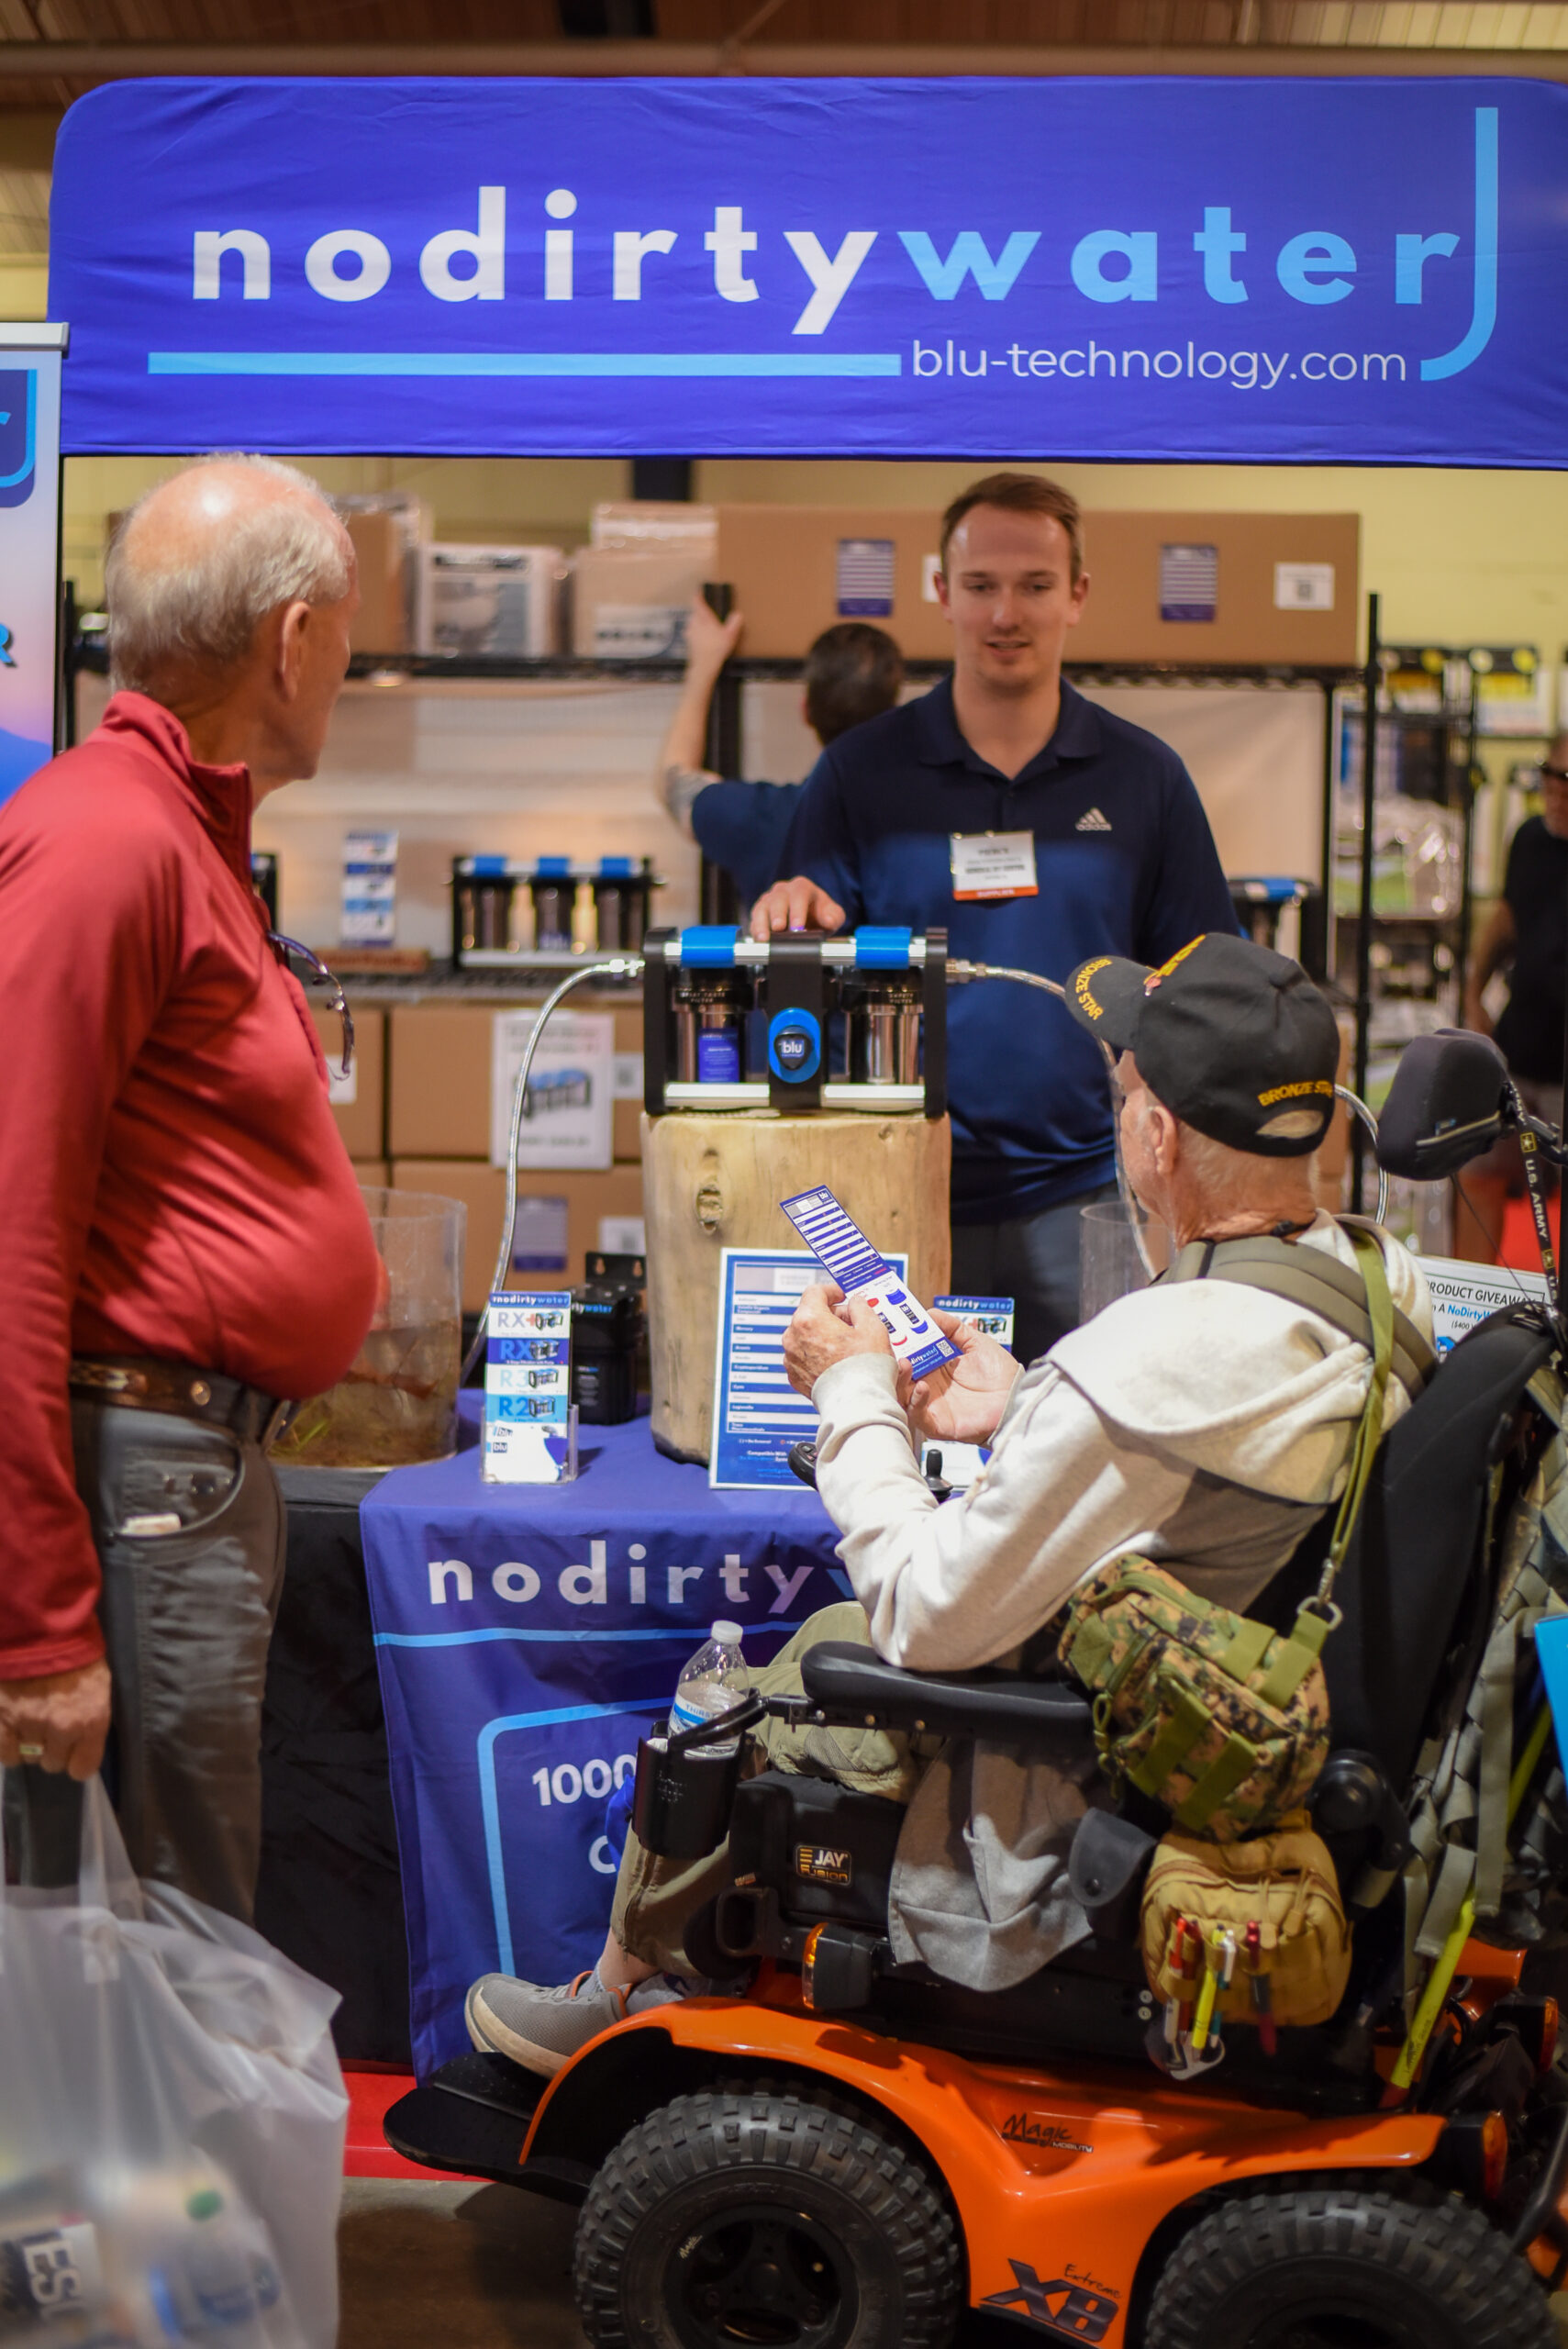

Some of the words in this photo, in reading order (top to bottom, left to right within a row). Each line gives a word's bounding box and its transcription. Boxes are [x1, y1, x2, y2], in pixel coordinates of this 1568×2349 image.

[912, 340, 1407, 389] blu-technology.com
[1075, 958, 1113, 994] BRONZE
[1078, 992, 1105, 1020] STAR
[783, 1041, 803, 1053] blu
[1257, 1082, 1315, 1108] BRONZE
[1531, 1192, 1548, 1240] ARMY
[1439, 1303, 1445, 1313] A
[498, 1396, 529, 1417] R2
[531, 1753, 638, 1807] 1000
[815, 1849, 844, 1868] JAY
[1003, 2112, 1073, 2147] Magic
[1052, 2141, 1093, 2154] MOBILITY
[1064, 2263, 1122, 2299] Extreme
[980, 2257, 1119, 2343] X8
